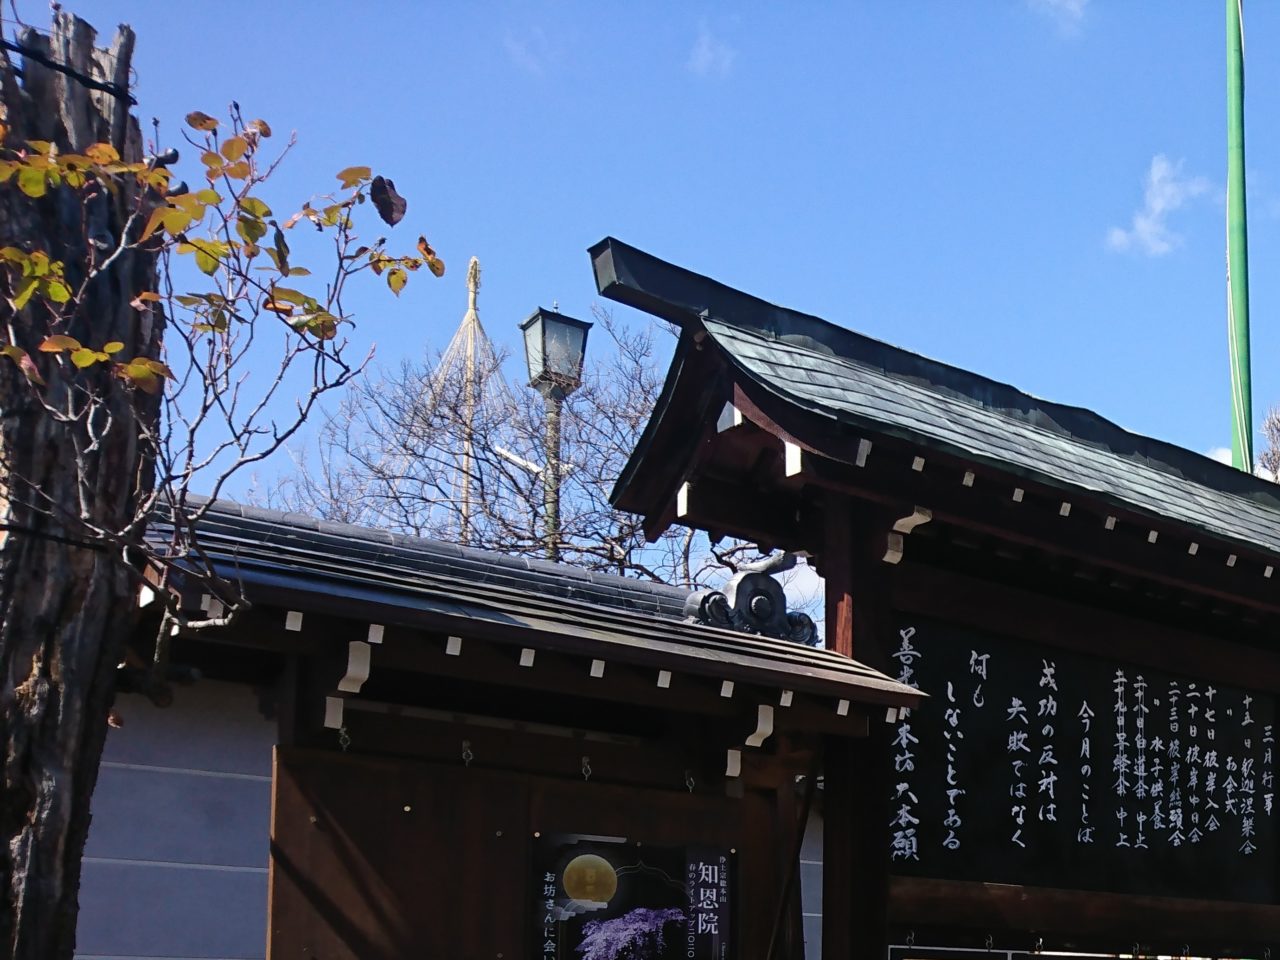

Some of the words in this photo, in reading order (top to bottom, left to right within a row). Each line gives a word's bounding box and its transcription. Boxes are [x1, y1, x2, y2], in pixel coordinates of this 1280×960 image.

[969, 649, 991, 708] 何も
[1037, 658, 1059, 822] 成功の反対は
[943, 680, 967, 850] しないことである
[1006, 696, 1032, 849] 失敗ではなく
[1077, 700, 1096, 844] 今月のことば
[1260, 725, 1275, 817] 三月行事
[697, 861, 720, 935] 知恩院
